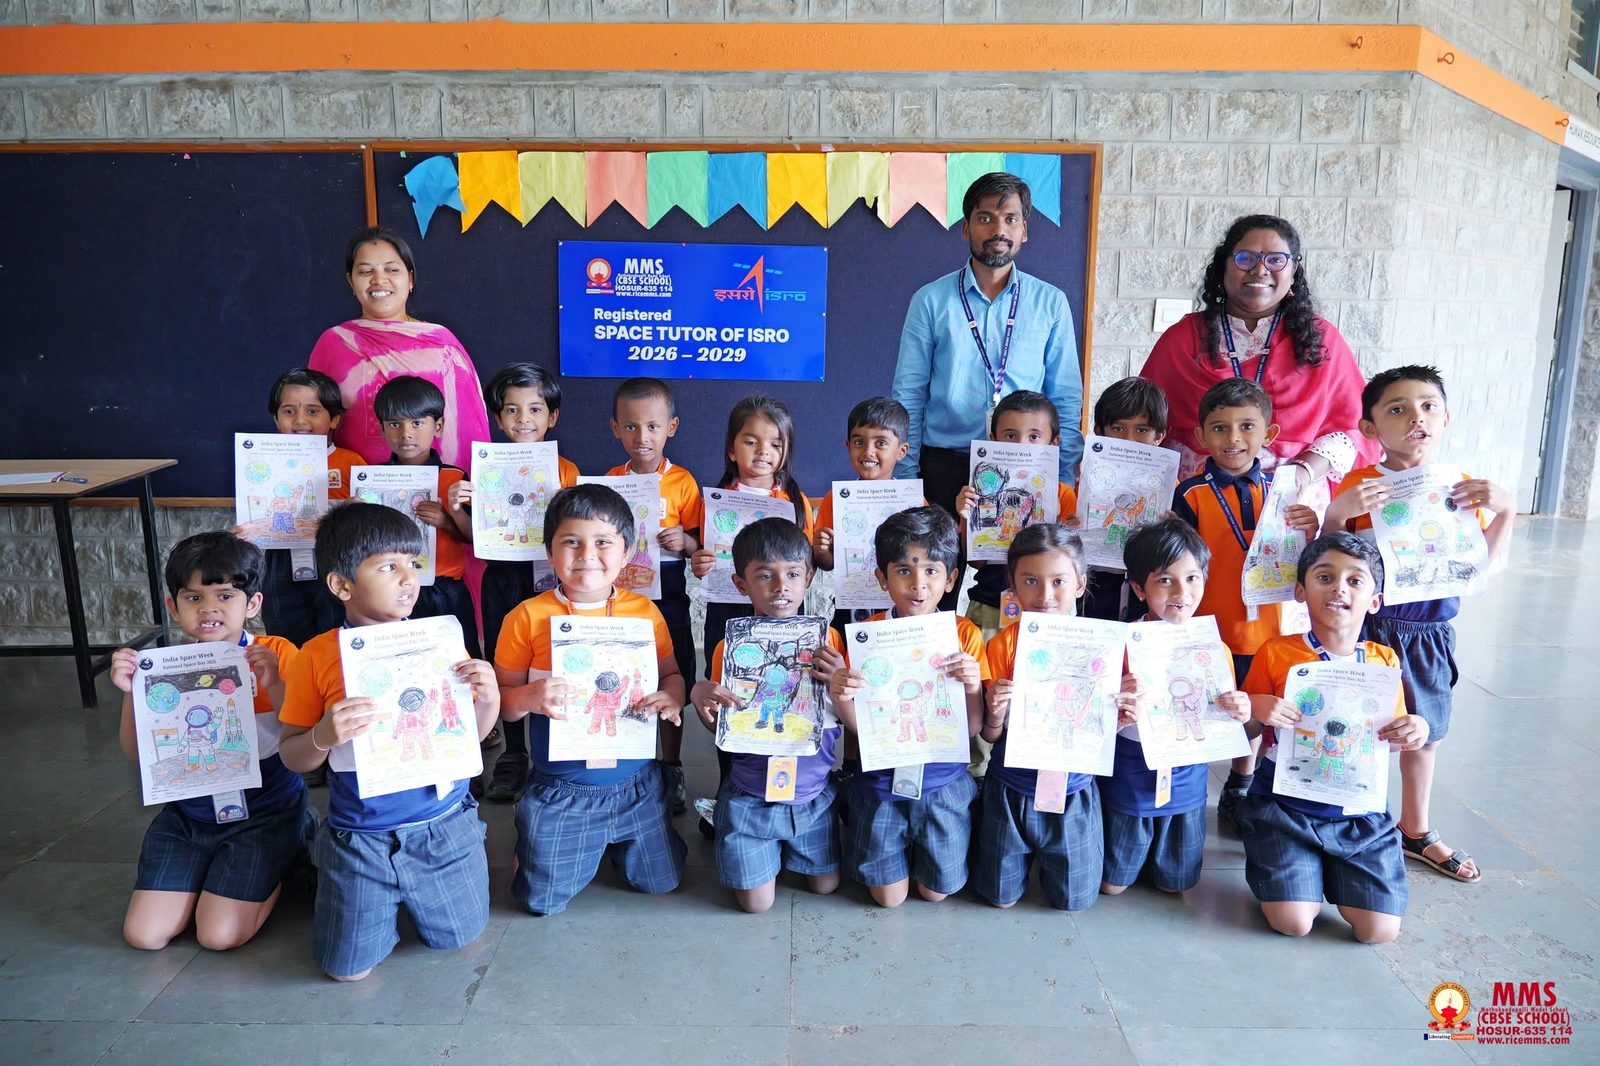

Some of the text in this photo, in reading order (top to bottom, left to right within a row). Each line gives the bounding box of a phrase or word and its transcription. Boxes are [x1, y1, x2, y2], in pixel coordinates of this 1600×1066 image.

[624, 258, 664, 274] MMS
[615, 276, 672, 287] (CBSE SCHOOL)
[594, 308, 672, 322] Registered
[594, 326, 790, 343] SPACE TUTOR OF ISRO
[628, 345, 678, 361] 2026
[696, 347, 747, 362] 2029
[1407, 474, 1424, 482] Space
